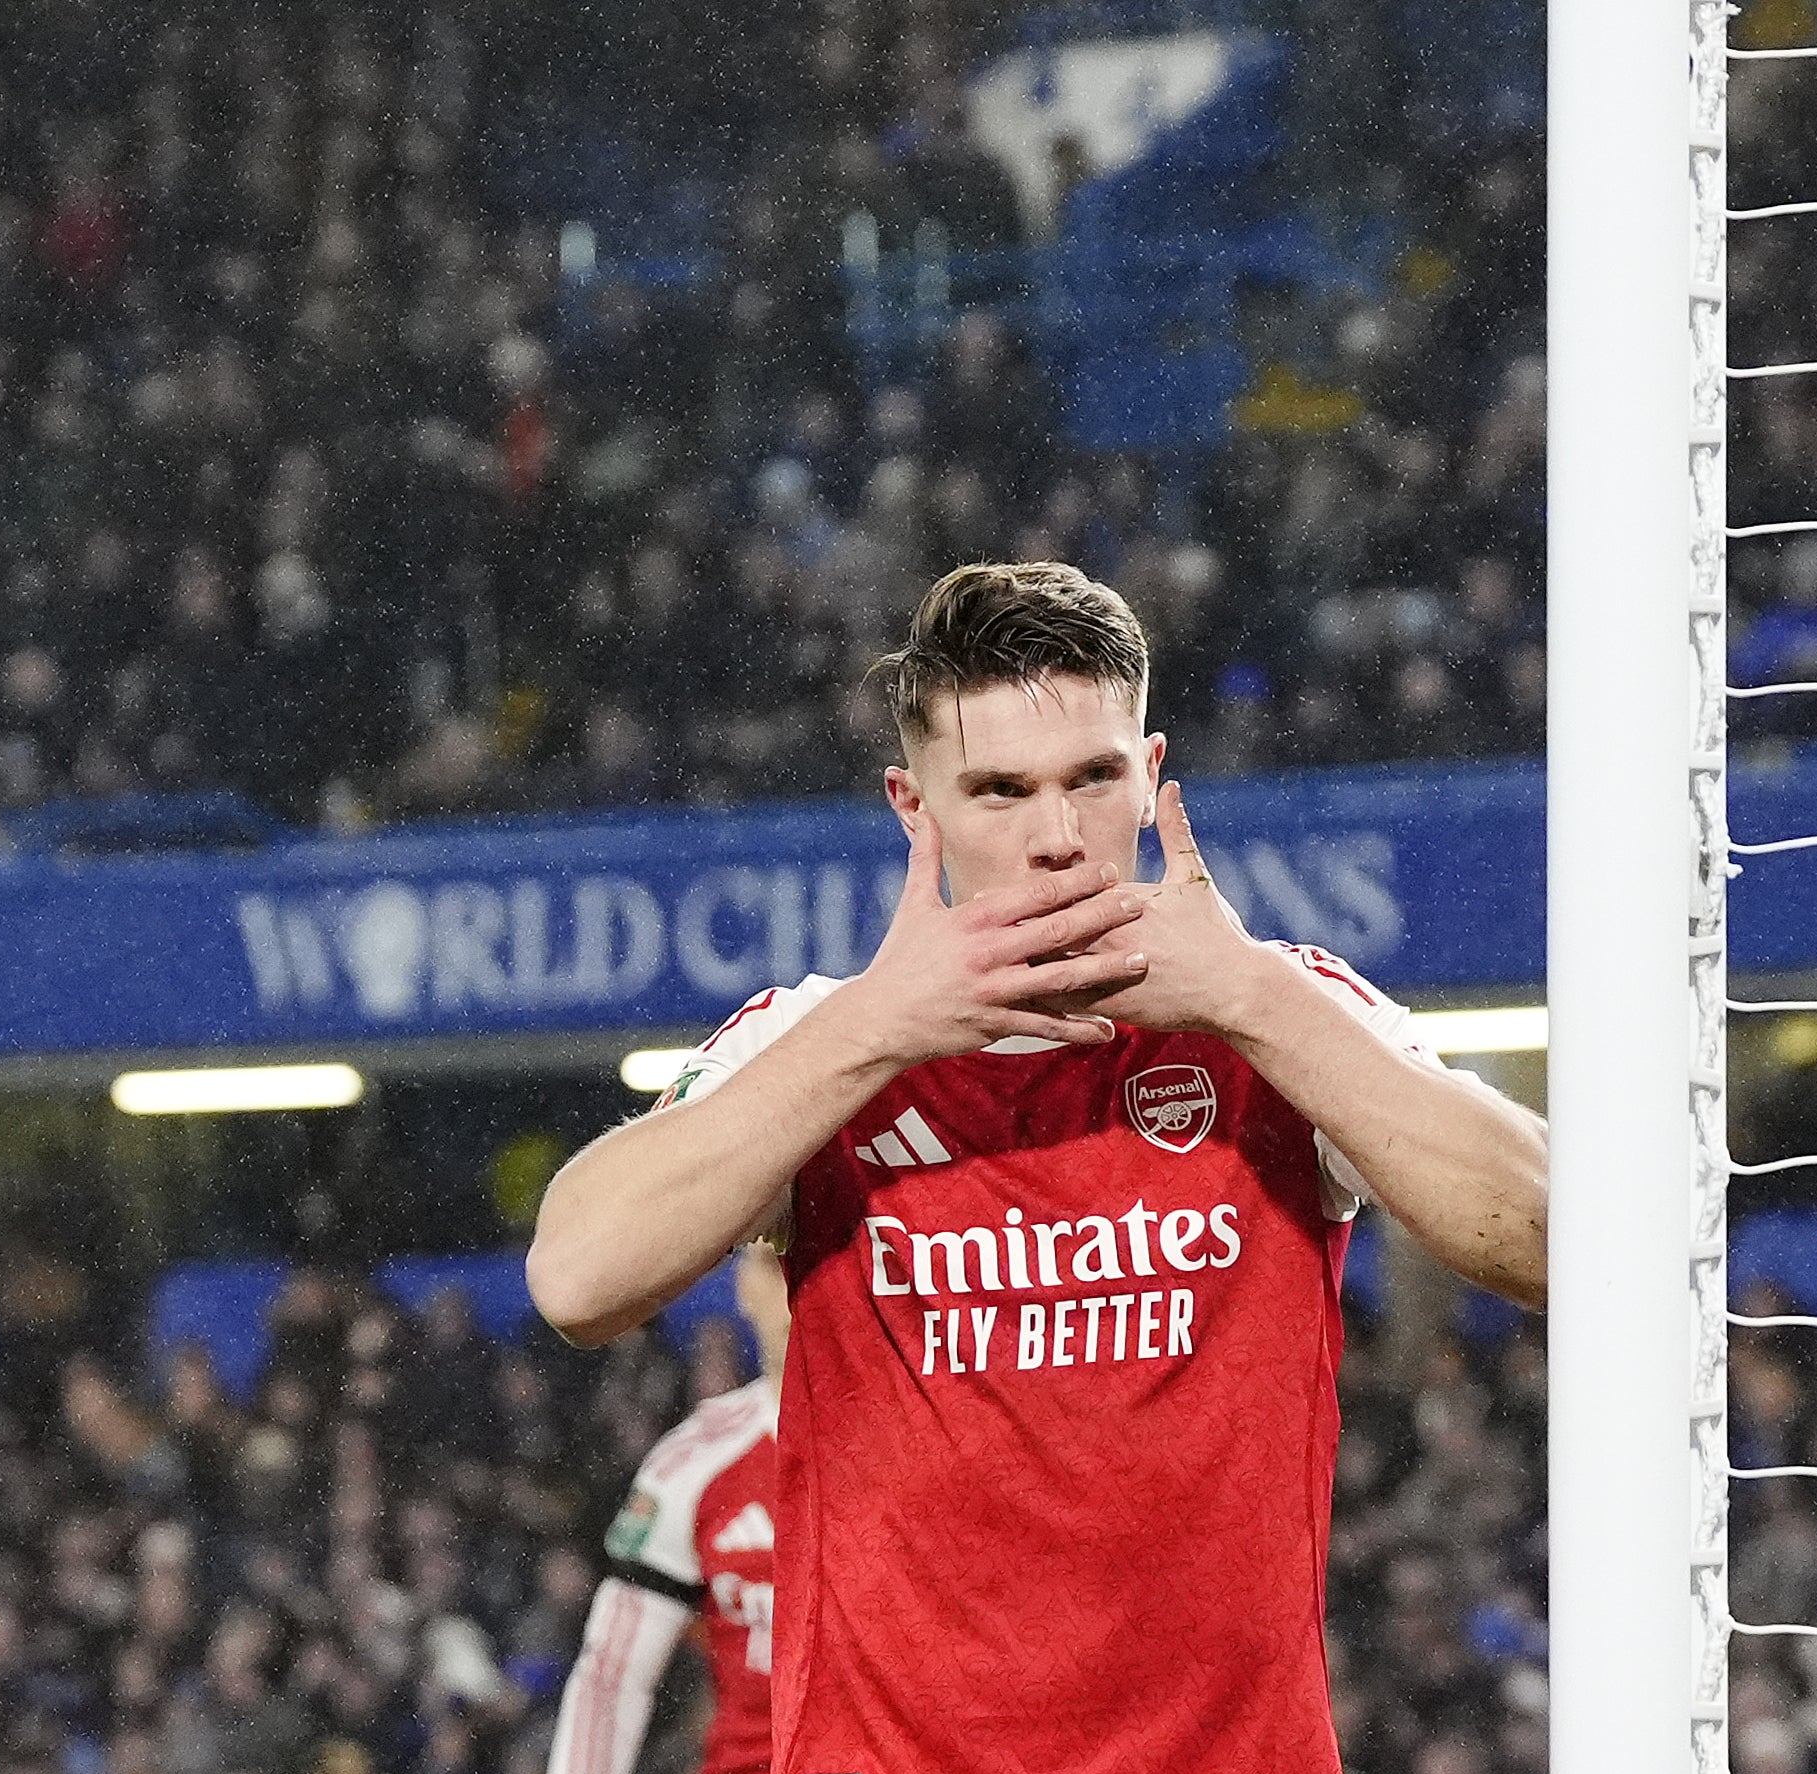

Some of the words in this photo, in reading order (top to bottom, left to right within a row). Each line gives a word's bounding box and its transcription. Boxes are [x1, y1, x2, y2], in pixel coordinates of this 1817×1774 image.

[235, 866, 668, 1020] WORLD
[1138, 1079, 1201, 1101] Arsenal
[864, 1198, 1242, 1297] Emirates
[922, 1306, 997, 1375] FLY
[1016, 1289, 1194, 1371] BETTER
